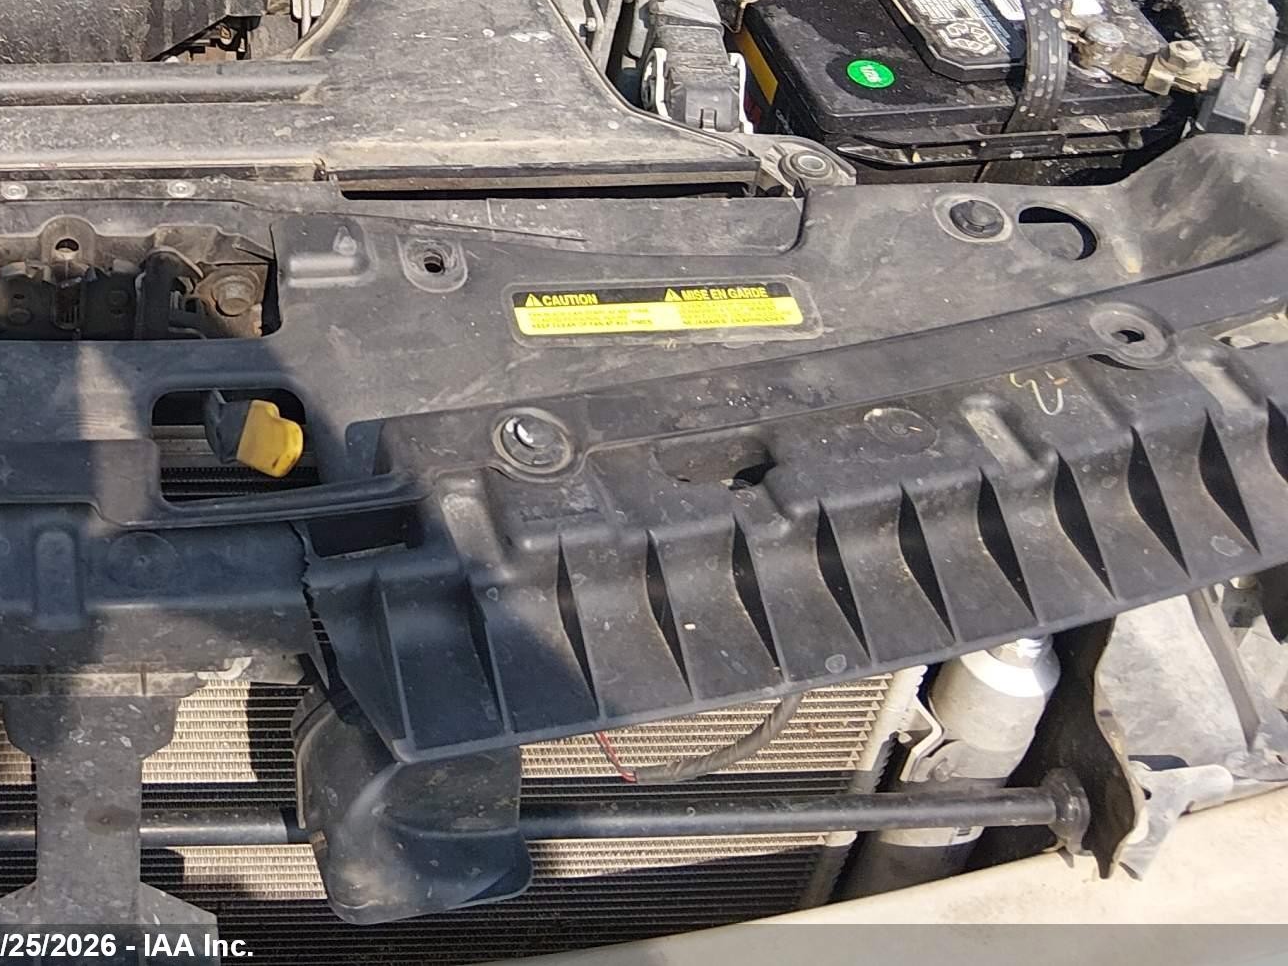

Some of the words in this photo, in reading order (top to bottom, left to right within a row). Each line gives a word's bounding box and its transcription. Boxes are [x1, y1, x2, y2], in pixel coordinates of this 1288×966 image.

[541, 293, 599, 307] CAUTION
[680, 289, 710, 301] MISE
[710, 288, 727, 300] EN
[727, 287, 769, 300] GARDE
